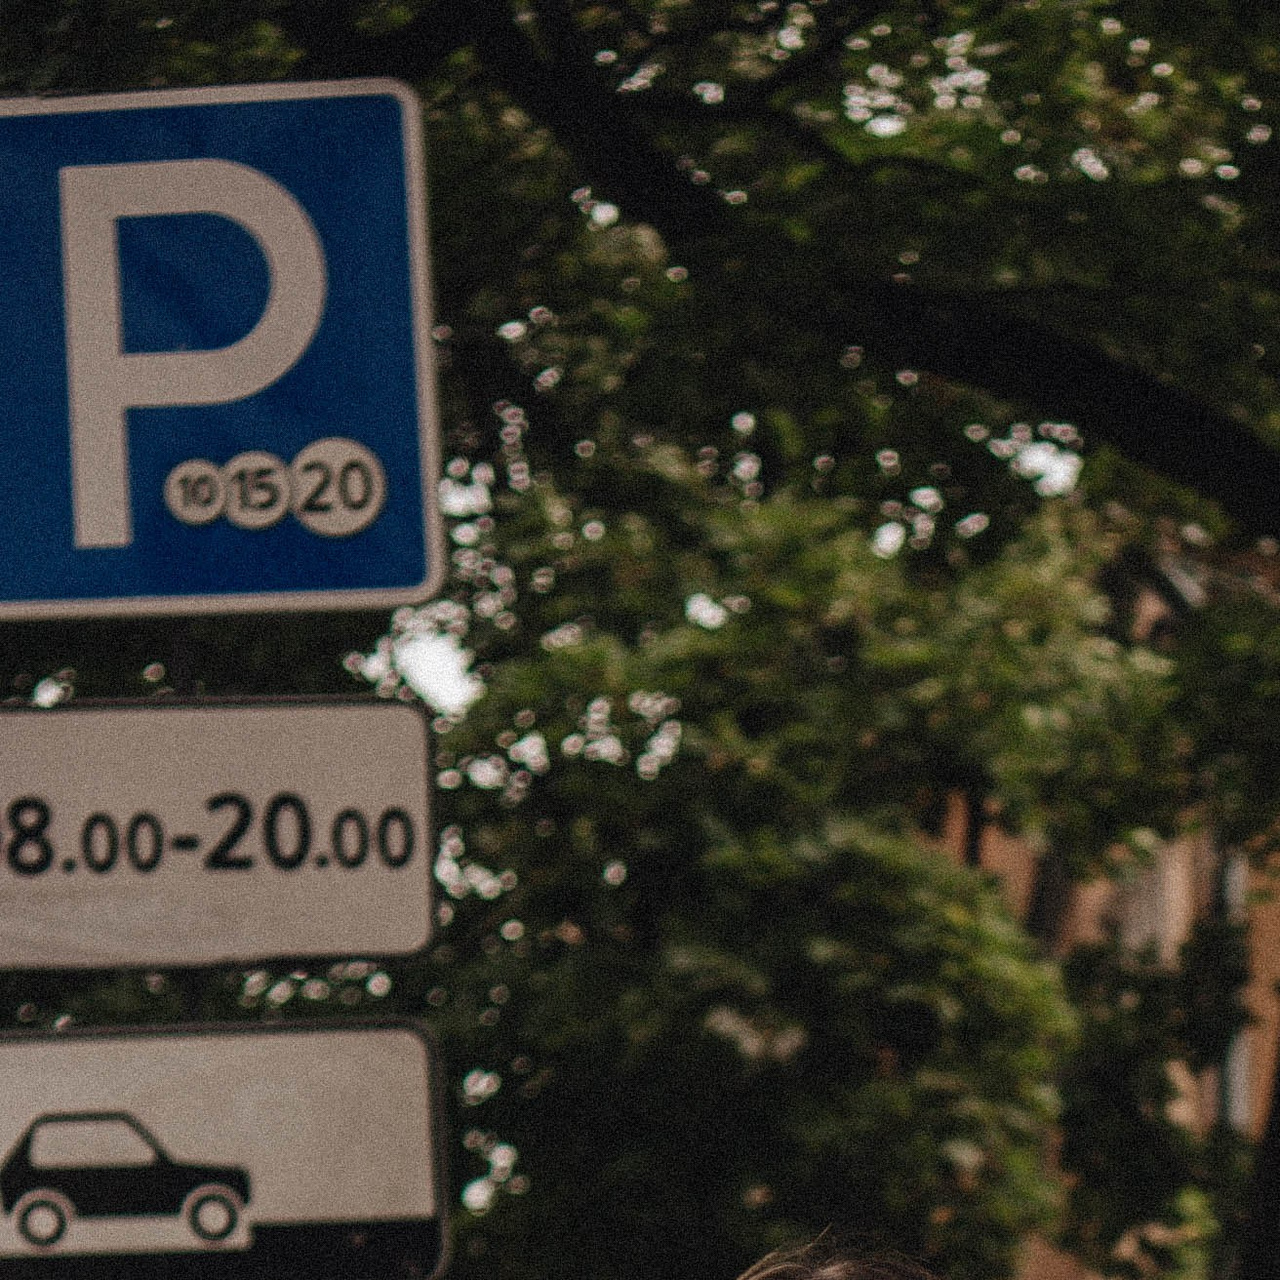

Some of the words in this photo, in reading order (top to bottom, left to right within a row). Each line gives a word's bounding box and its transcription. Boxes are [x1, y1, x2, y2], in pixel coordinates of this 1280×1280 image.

[60, 157, 327, 549] P
[179, 474, 217, 507] 10
[231, 467, 281, 511] 15
[302, 460, 373, 513] 20
[0, 791, 414, 876] 8.00-20.00
